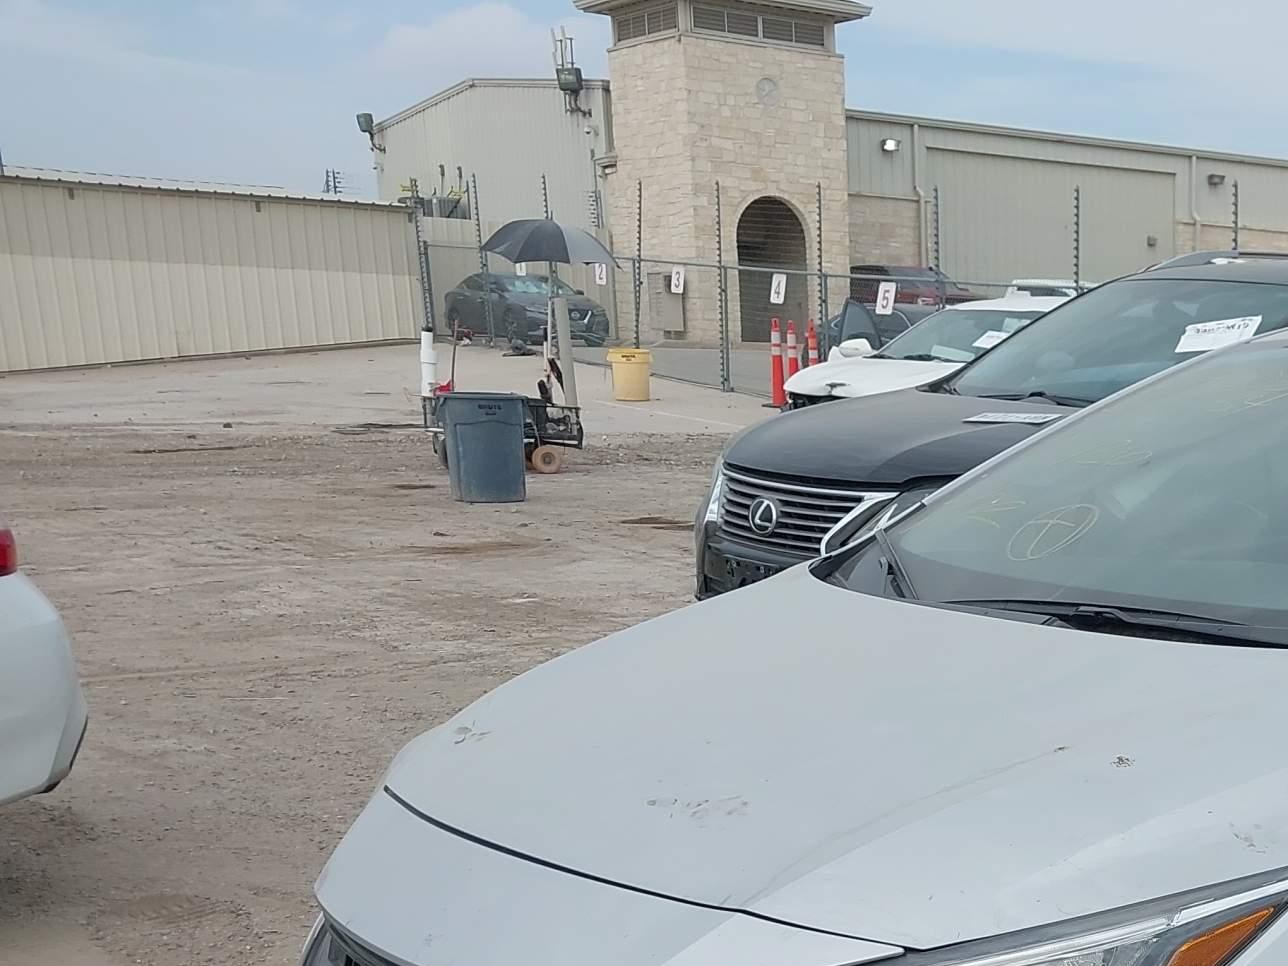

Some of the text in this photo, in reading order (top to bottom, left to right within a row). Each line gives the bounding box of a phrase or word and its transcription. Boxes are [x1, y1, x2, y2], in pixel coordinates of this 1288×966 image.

[598, 263, 604, 280] 2
[674, 271, 681, 288] 3
[774, 279, 782, 300] 4
[881, 289, 890, 309] 5
